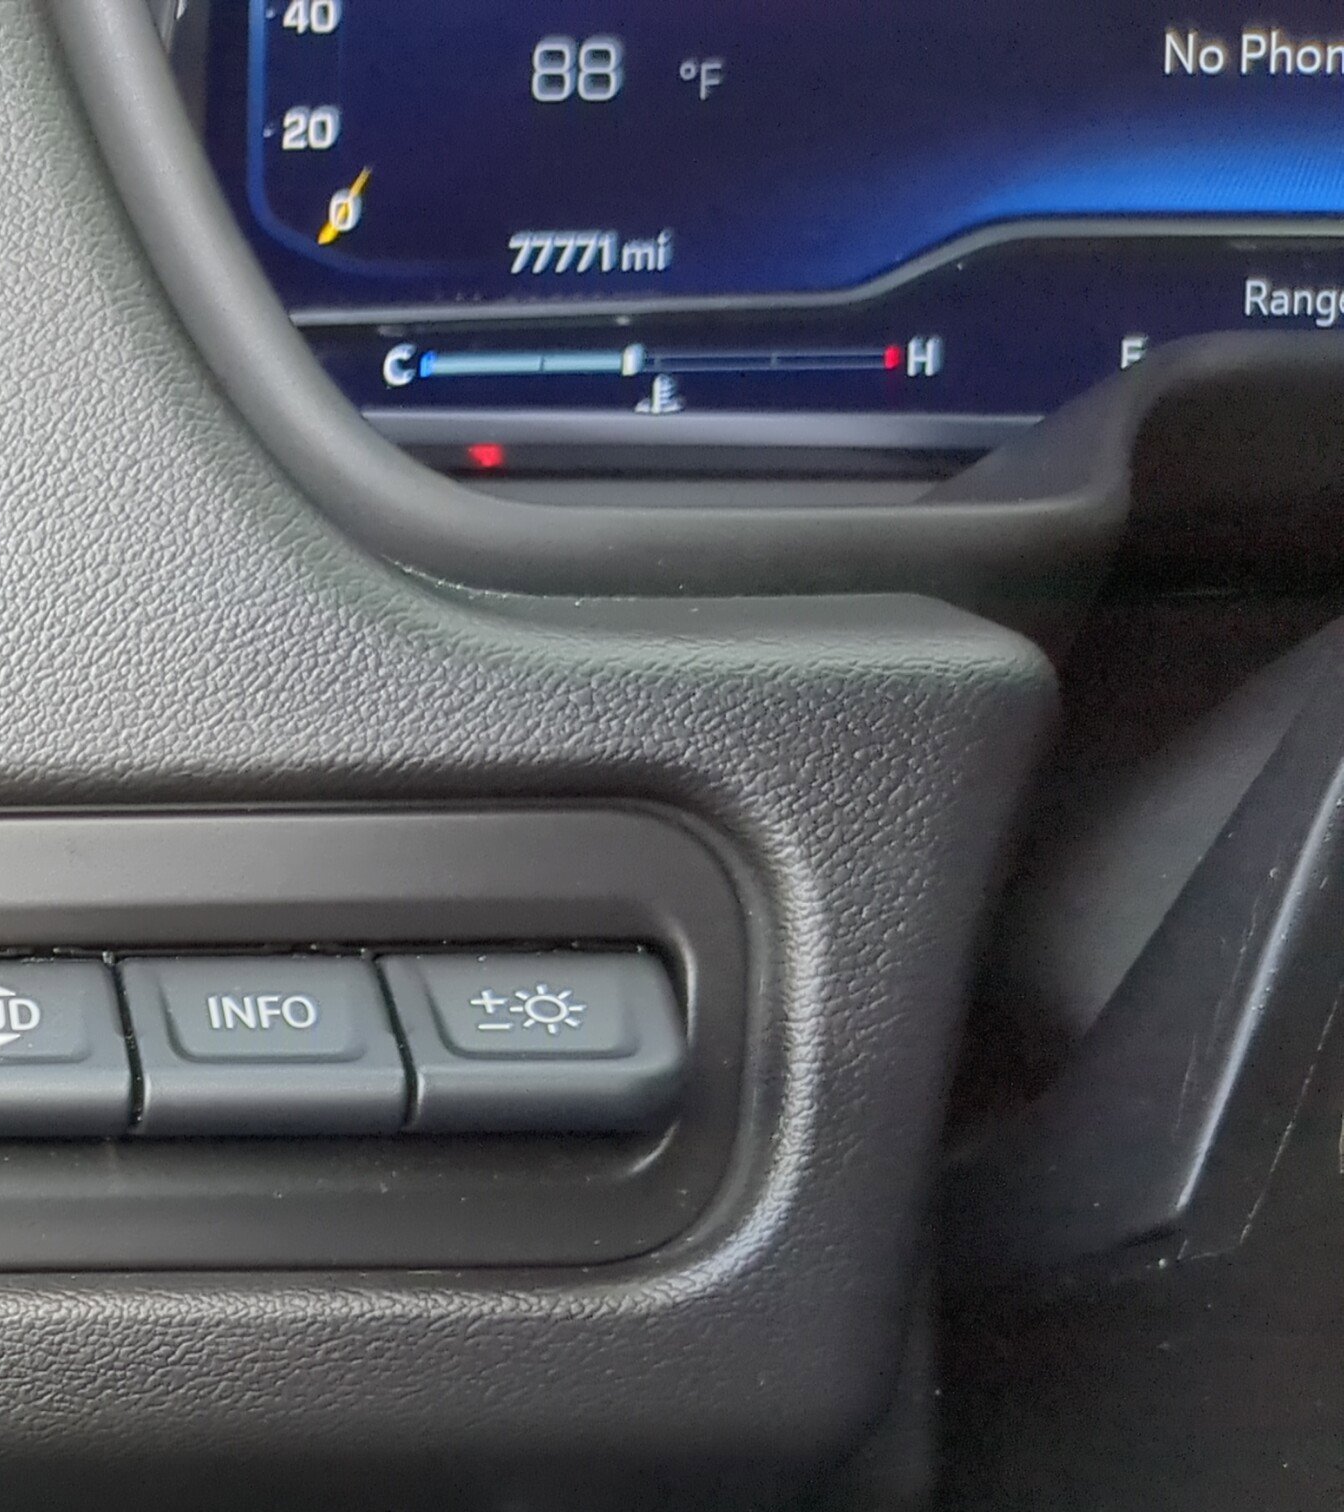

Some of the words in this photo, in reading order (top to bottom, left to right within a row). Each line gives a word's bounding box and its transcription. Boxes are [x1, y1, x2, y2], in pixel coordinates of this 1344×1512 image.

[282, 0, 342, 34] 40
[531, 34, 624, 101] 88
[1163, 28, 1225, 75] No
[1240, 28, 1344, 75] Phon
[281, 106, 341, 150] 20
[328, 190, 362, 232] 0
[509, 230, 619, 274] 77771
[621, 229, 673, 273] mi
[1244, 278, 1344, 328] Rang
[382, 344, 416, 386] C
[907, 335, 943, 377] H
[208, 996, 317, 1029] INFO
